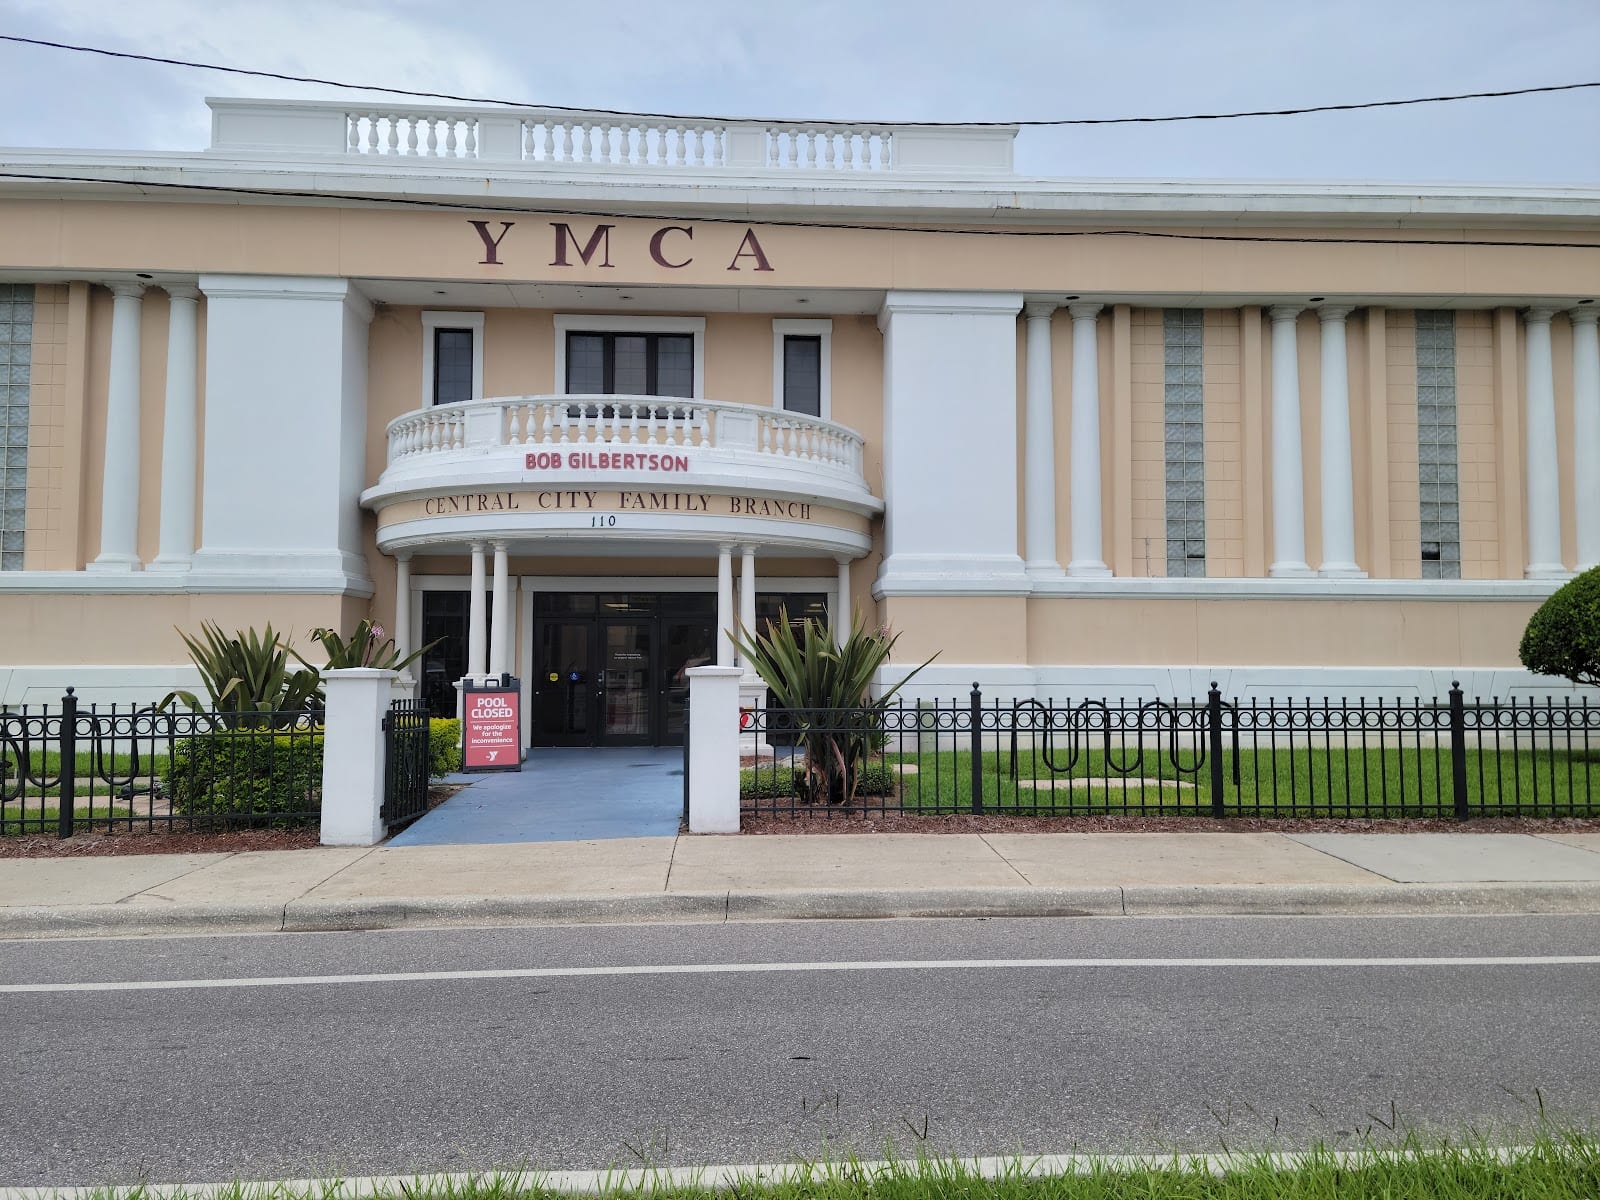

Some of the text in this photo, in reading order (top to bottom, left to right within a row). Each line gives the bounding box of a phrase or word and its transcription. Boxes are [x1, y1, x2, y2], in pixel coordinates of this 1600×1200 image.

[467, 220, 775, 271] YMCA
[525, 452, 689, 472] BOB GILBERTSON
[425, 491, 811, 520] CENTRAL CITY FAMILY BRANCH
[591, 515, 616, 528] 110
[477, 698, 507, 707] POOL
[471, 708, 512, 718] CLOSED
